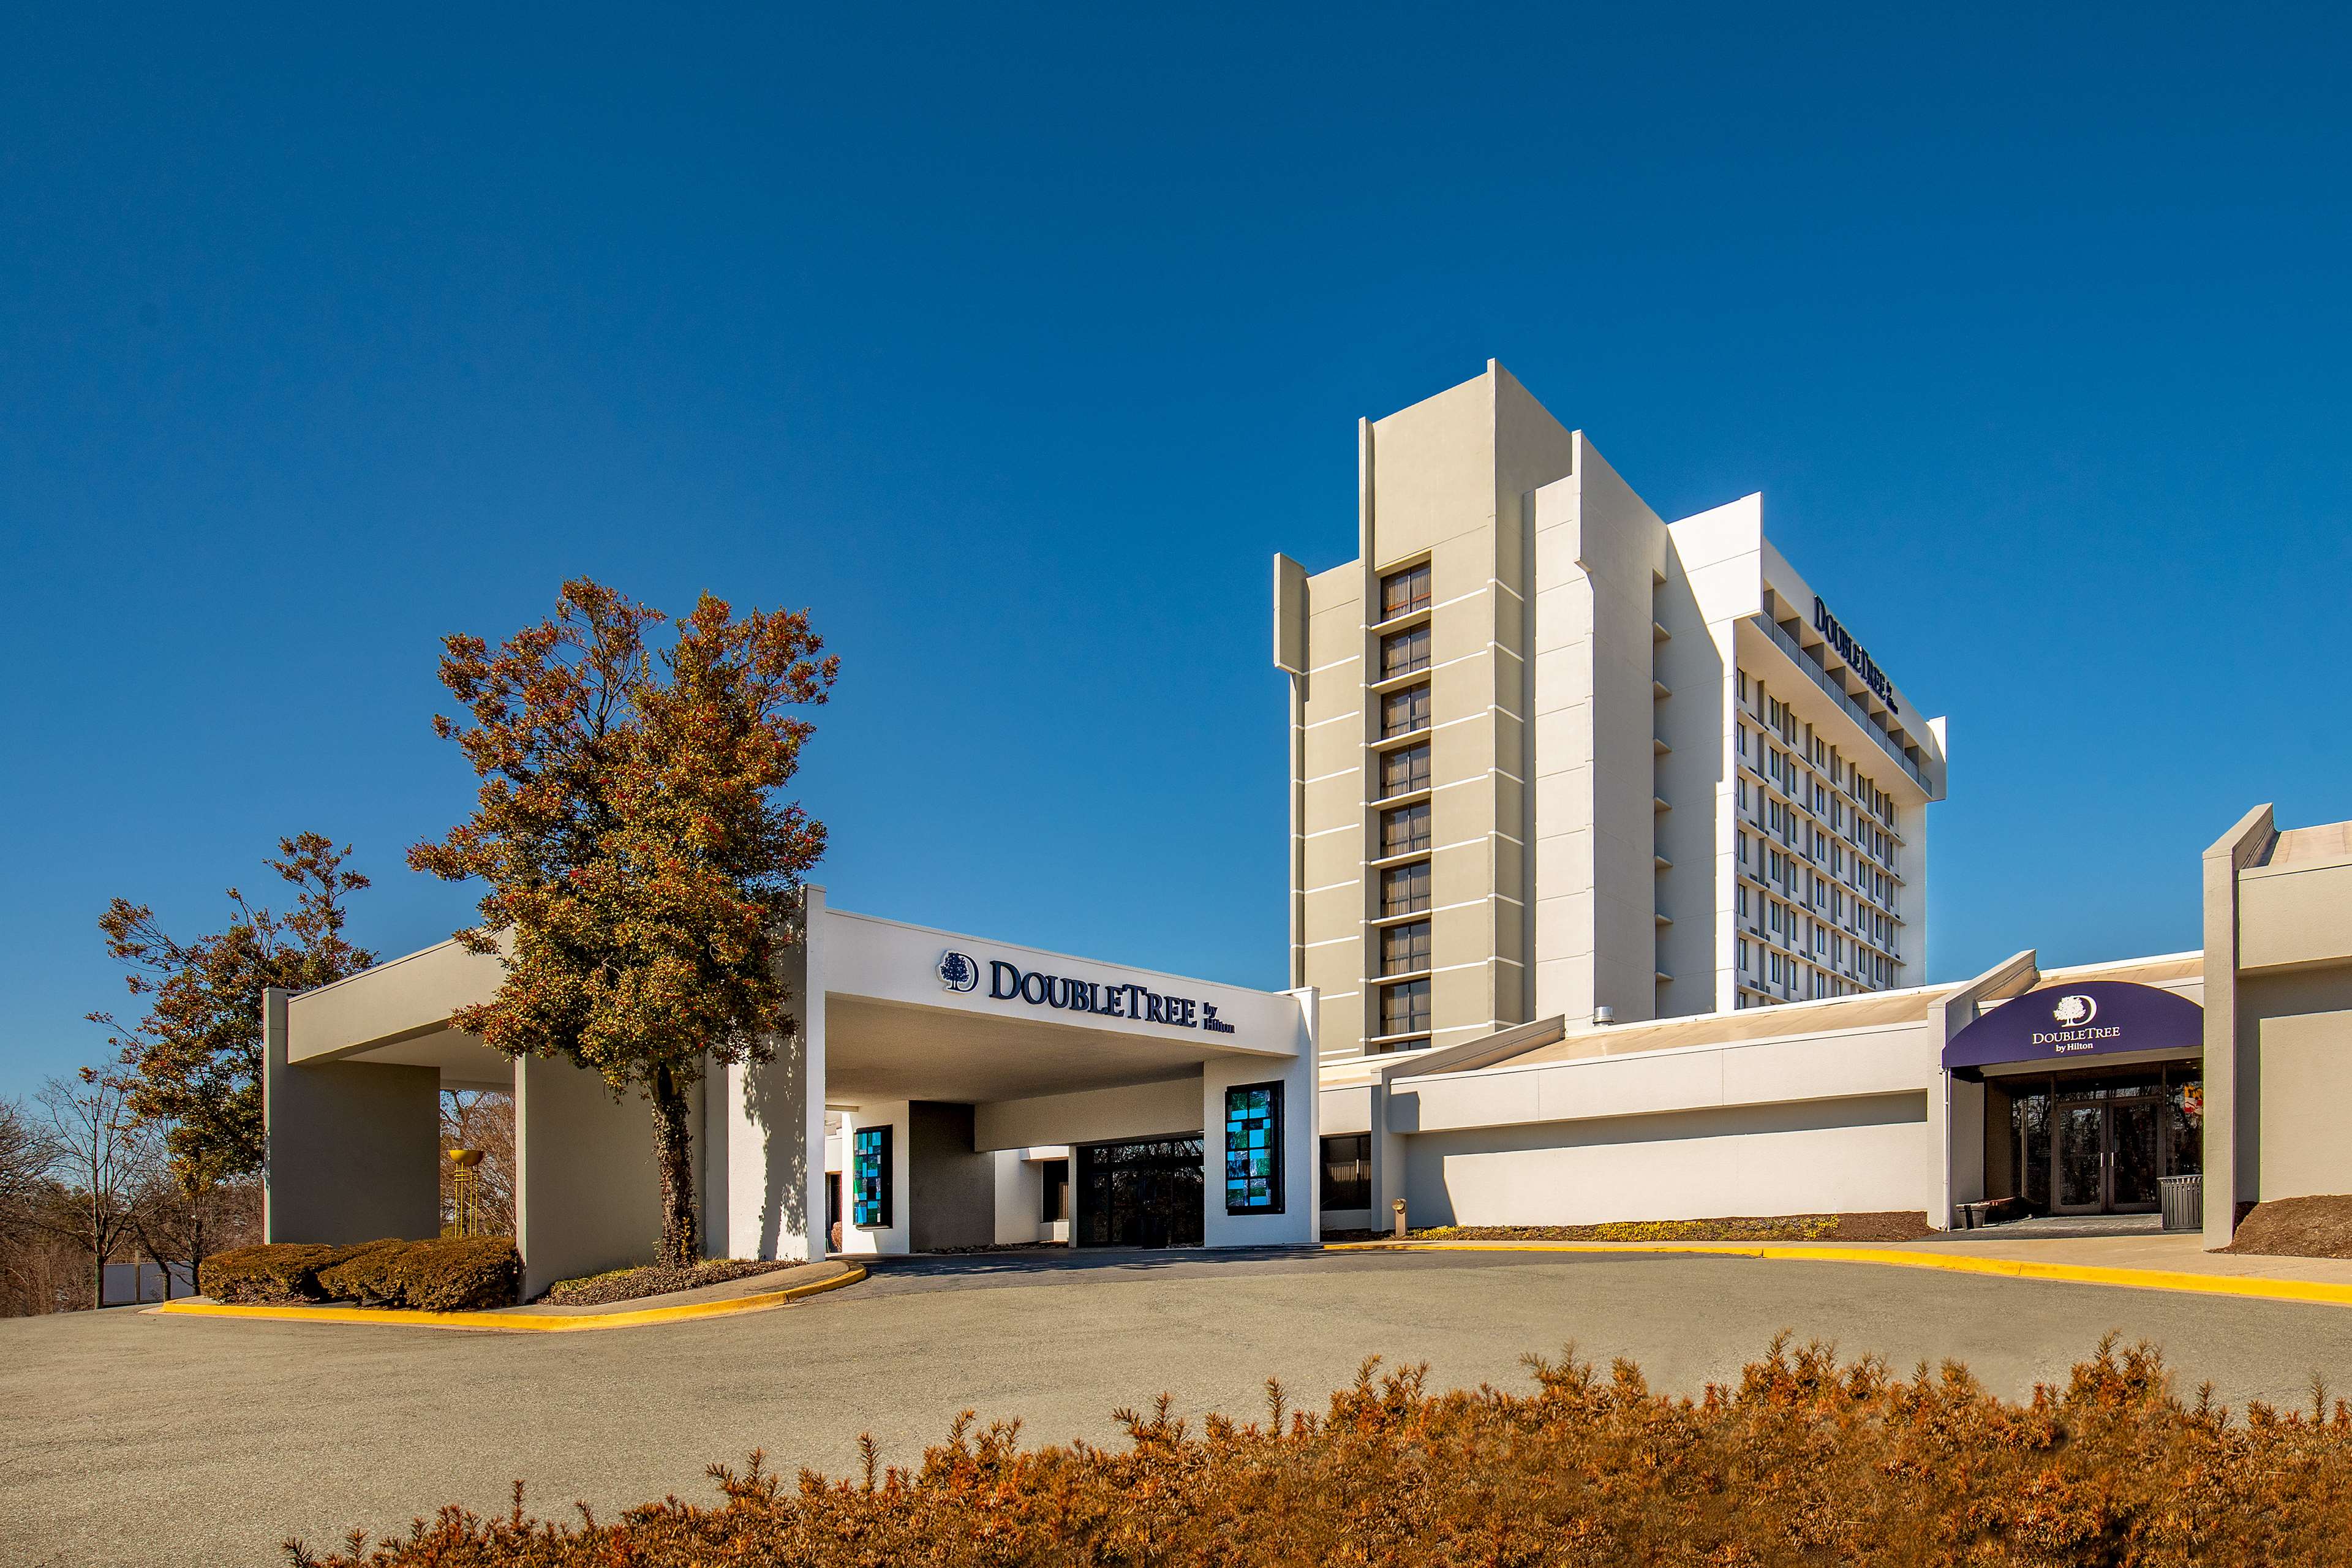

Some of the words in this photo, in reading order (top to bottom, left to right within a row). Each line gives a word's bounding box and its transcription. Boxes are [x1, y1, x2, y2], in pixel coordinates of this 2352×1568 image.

[1814, 595, 1886, 701] DOUBLETREE
[989, 960, 1197, 1028] DOUBLETREE
[1204, 1001, 1218, 1018] by
[1204, 1018, 1235, 1034] Hilton
[2032, 1027, 2120, 1044] DOUBLETREE
[2056, 1044, 2067, 1053] by
[2067, 1042, 2094, 1051] Hilton
